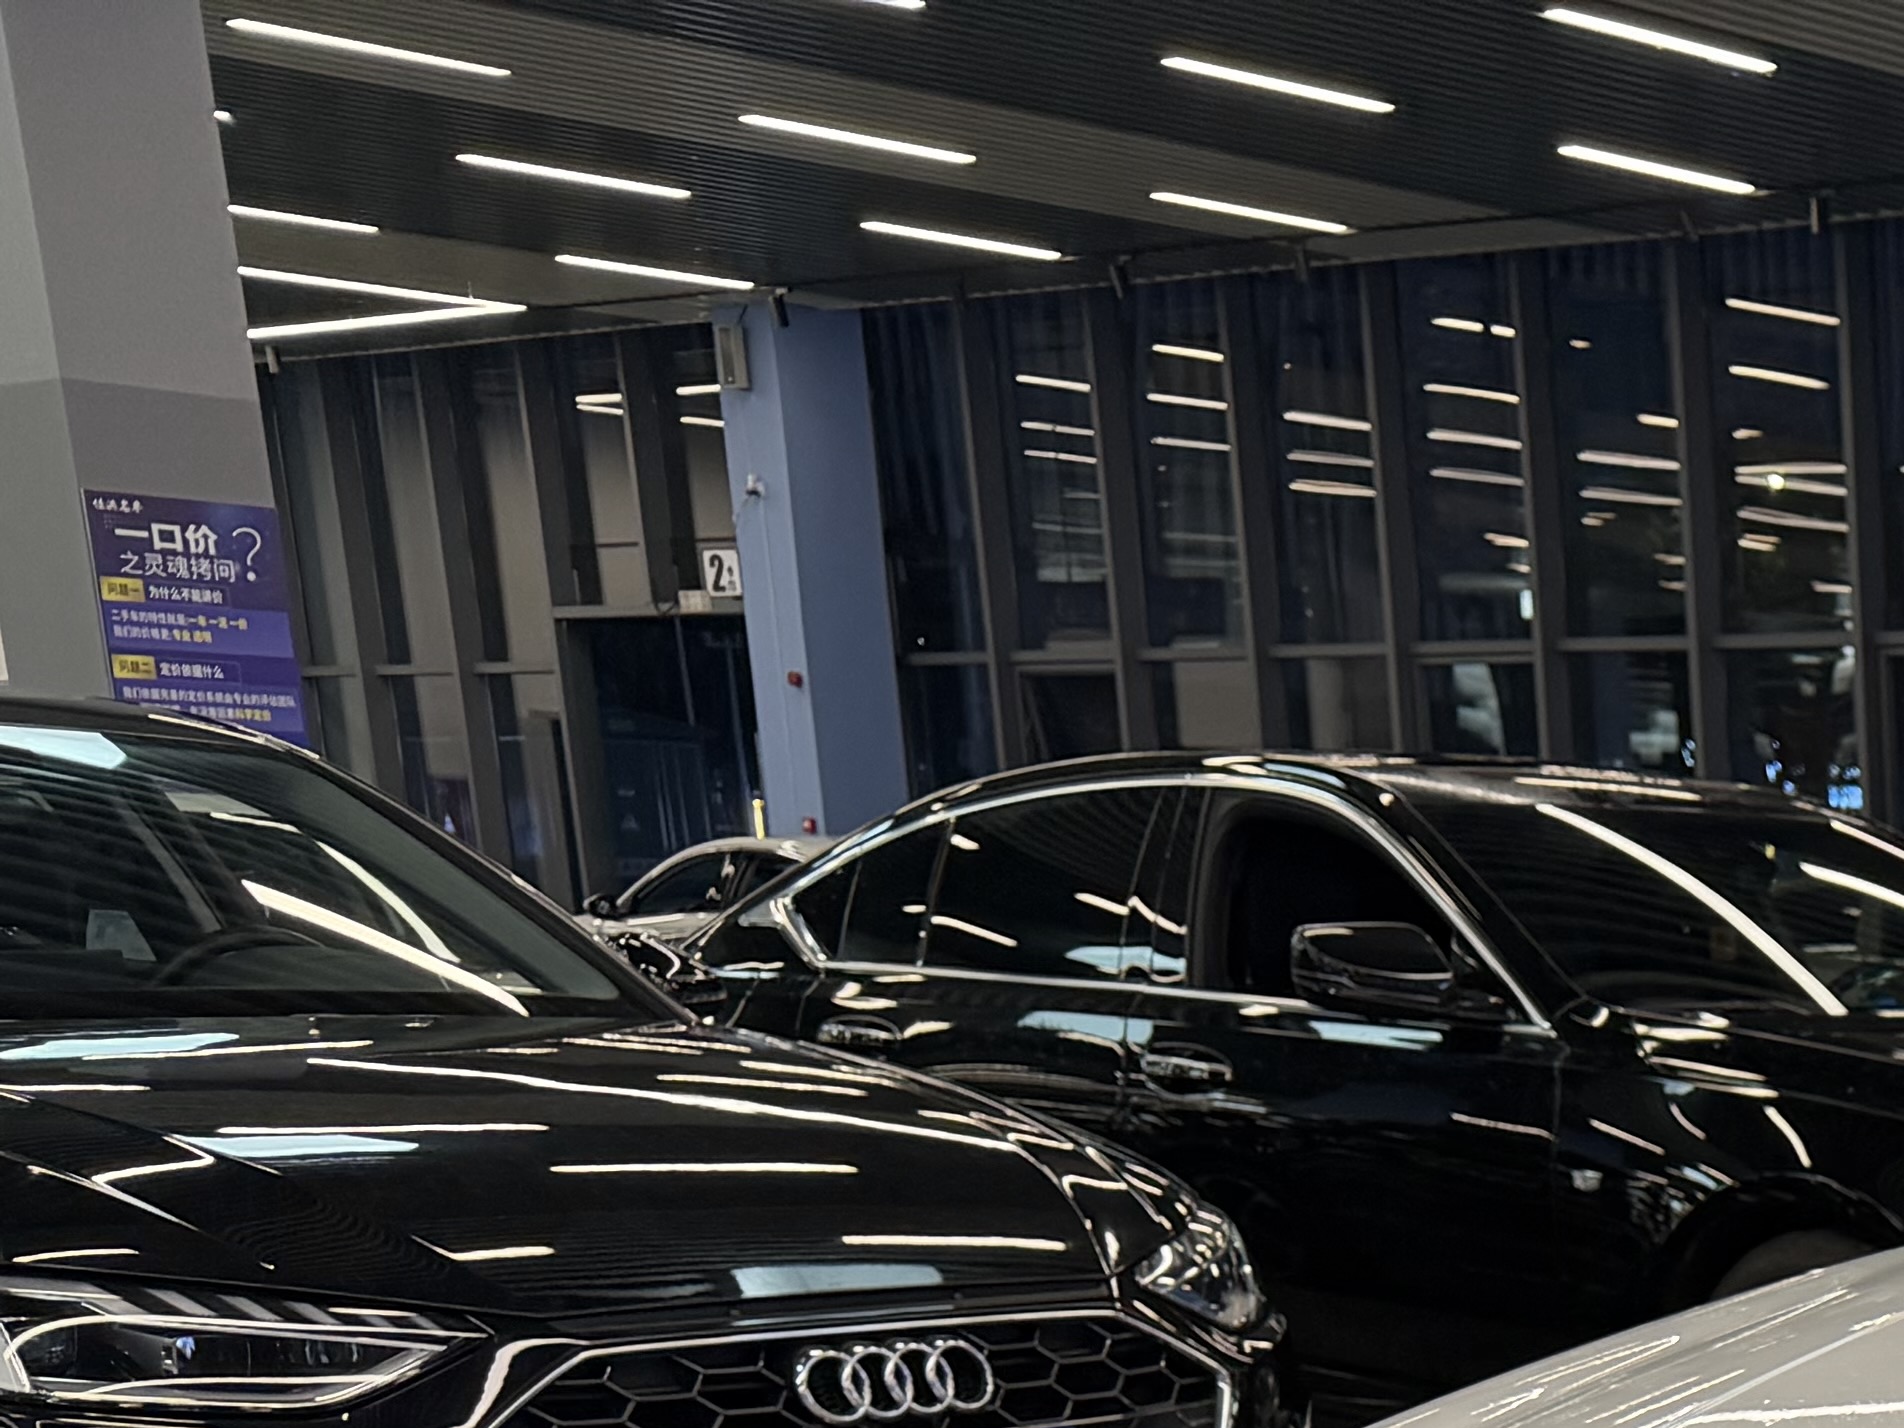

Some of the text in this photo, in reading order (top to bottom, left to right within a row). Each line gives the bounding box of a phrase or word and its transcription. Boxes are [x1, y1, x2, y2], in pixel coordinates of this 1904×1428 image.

[113, 522, 218, 556] 一口价
[119, 550, 236, 583] 之灵魂拷问
